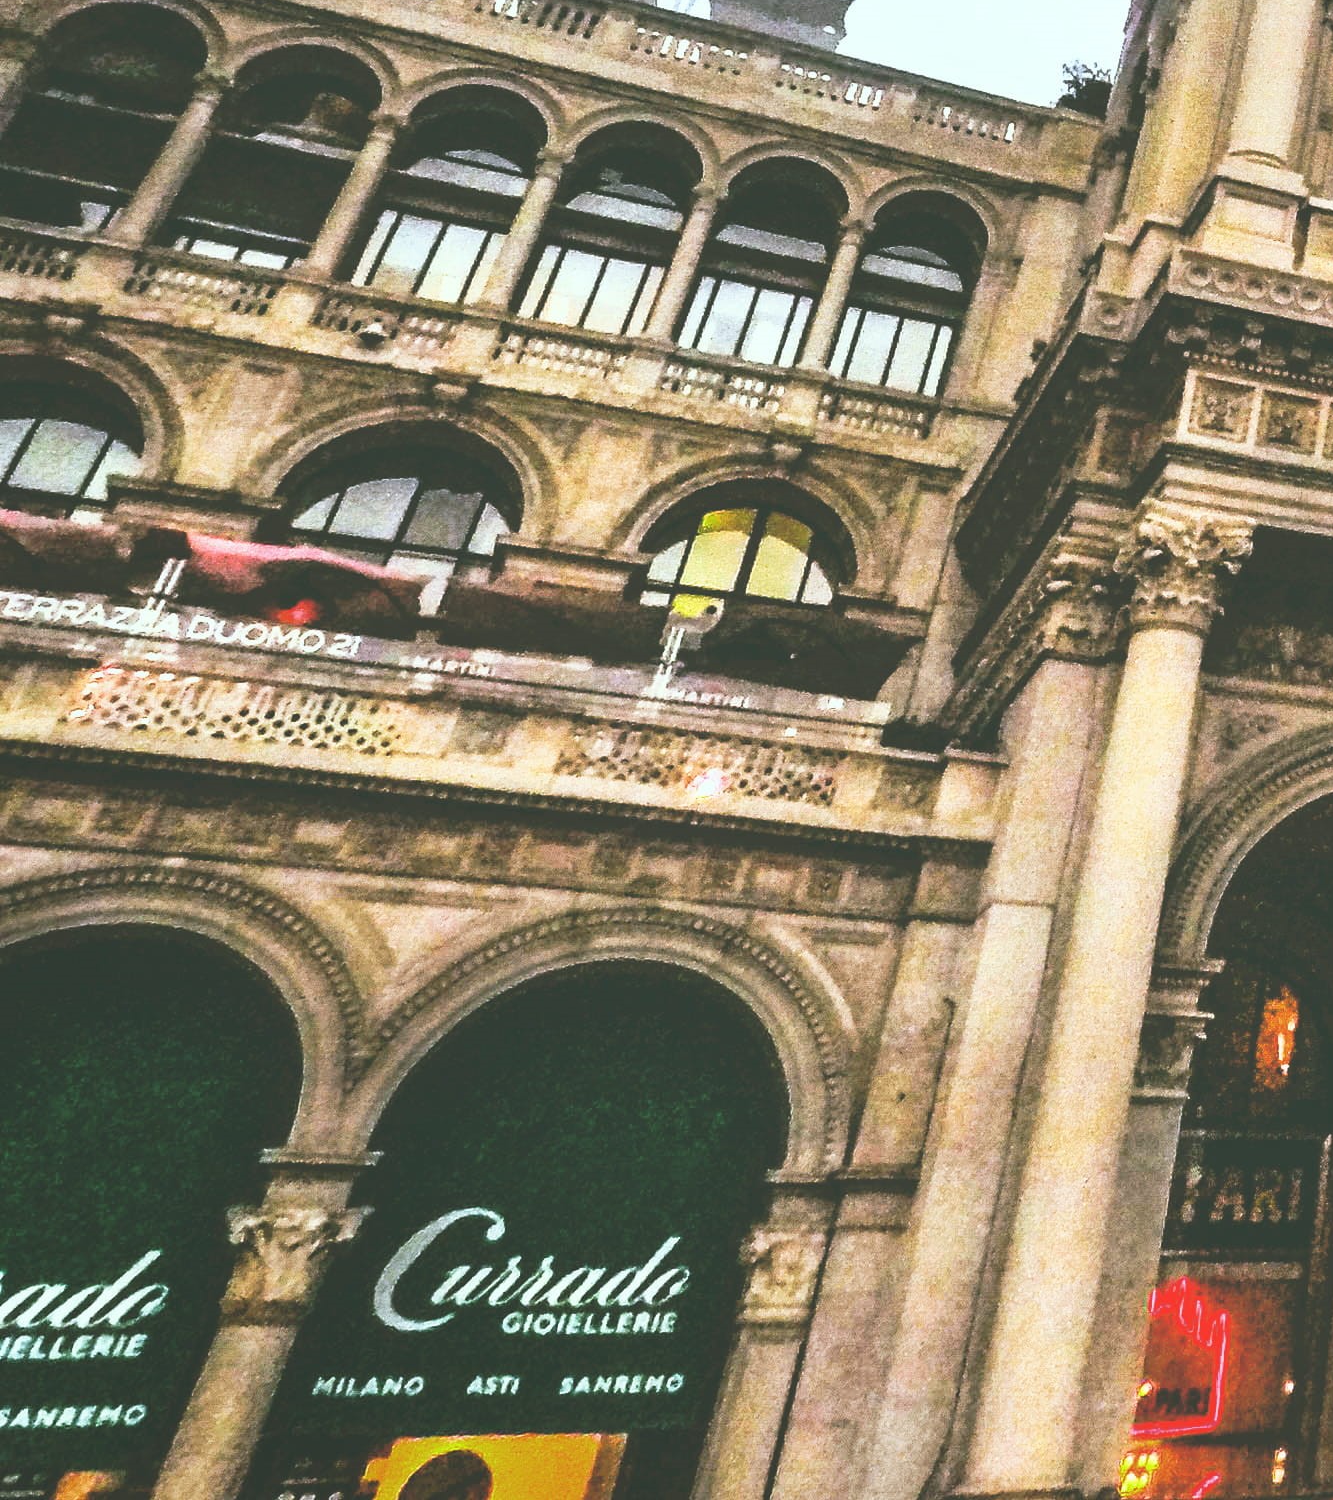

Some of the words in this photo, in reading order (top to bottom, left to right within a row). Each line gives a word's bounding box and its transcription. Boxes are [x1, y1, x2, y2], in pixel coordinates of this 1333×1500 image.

[186, 614, 326, 654] DUOMO
[329, 634, 362, 658] 21
[373, 1206, 690, 1332] Currado
[501, 1311, 678, 1334] GIOIELLERIE
[311, 1375, 425, 1397] MILANO
[466, 1375, 520, 1395] ASTI
[559, 1372, 685, 1395] SANREMO
